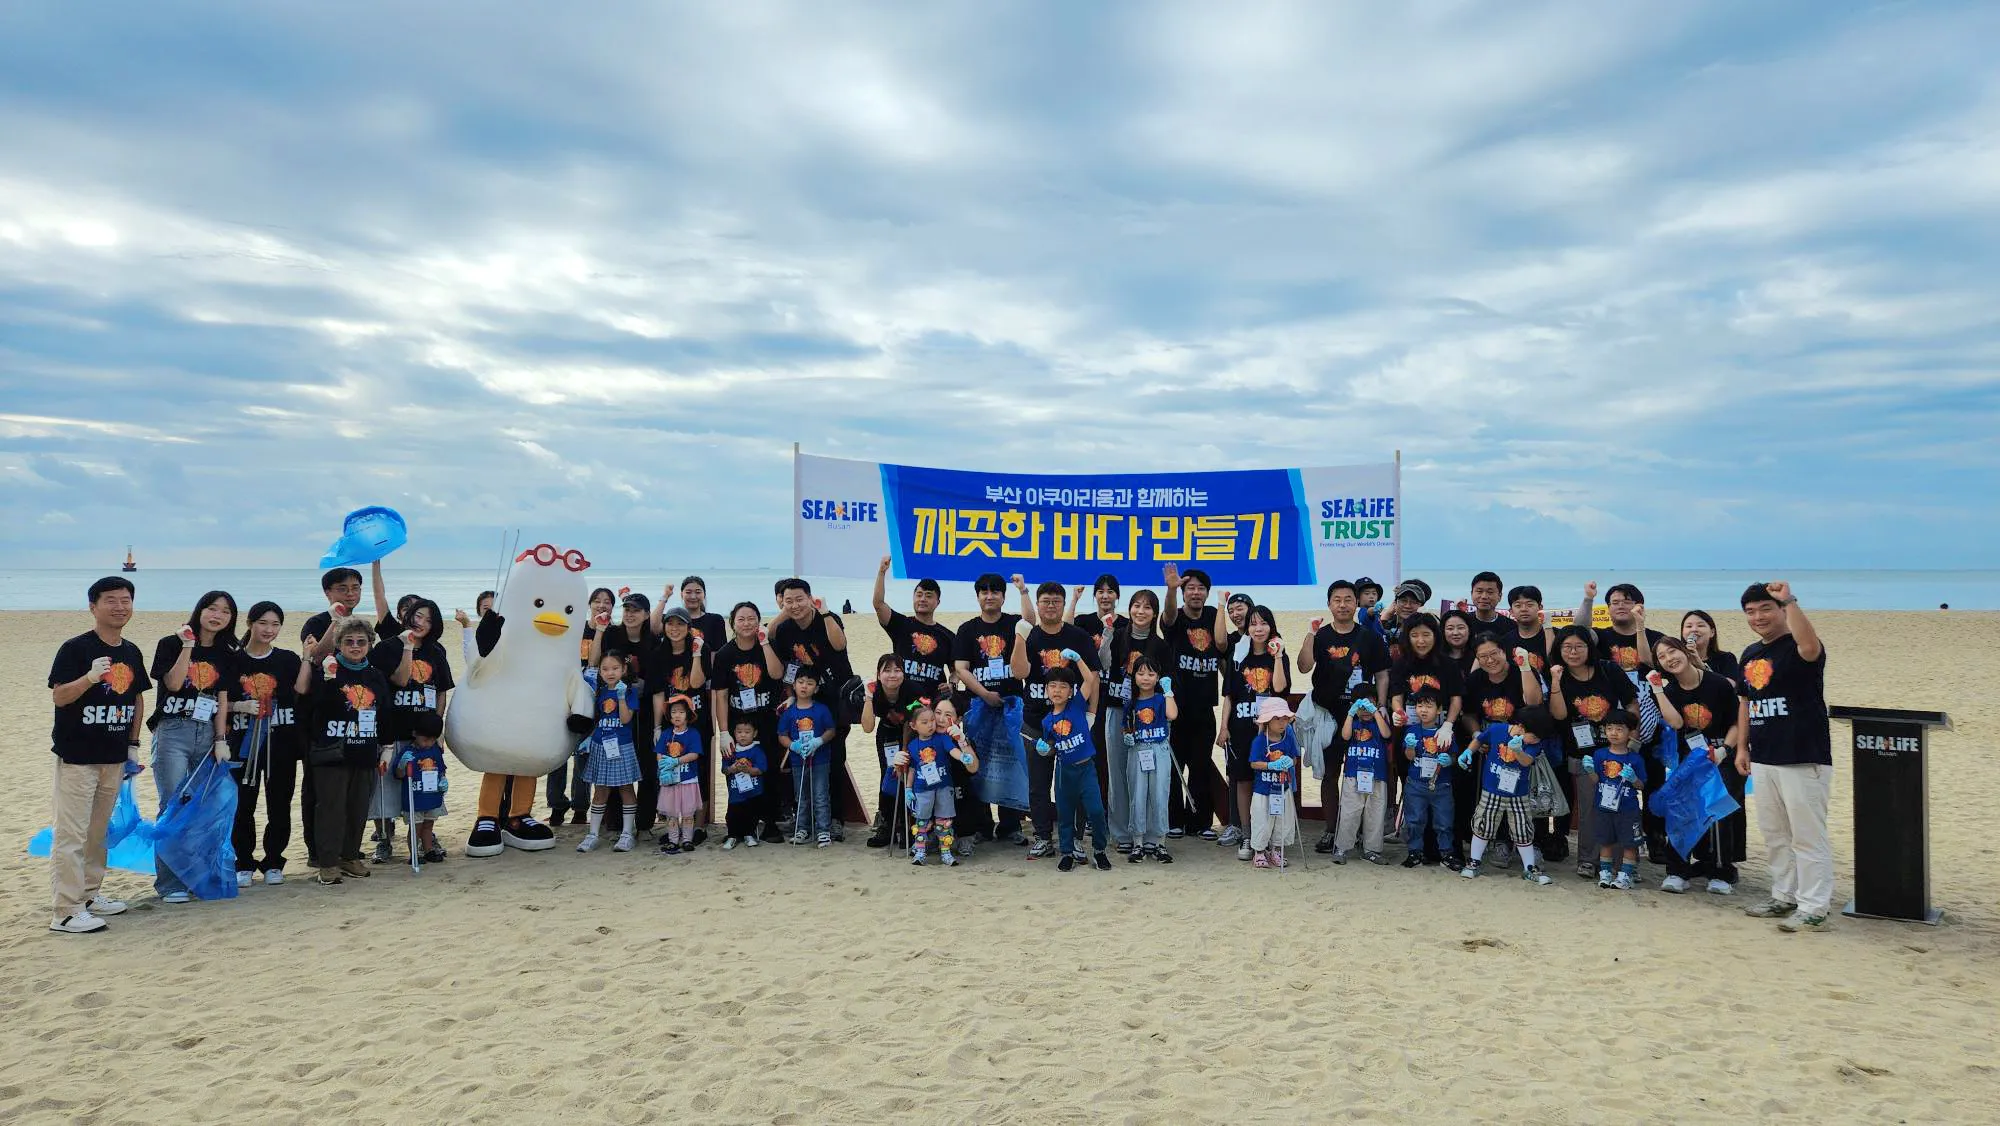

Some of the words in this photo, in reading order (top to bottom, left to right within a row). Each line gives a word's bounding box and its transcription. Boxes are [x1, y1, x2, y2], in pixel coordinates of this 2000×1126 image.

[985, 485, 1022, 505] 부산
[1025, 487, 1133, 508] 아쿠아리움과
[1137, 487, 1209, 508] 함께하는
[801, 499, 837, 520] SEA
[1321, 499, 1356, 519] SEA
[827, 522, 851, 530] Busan
[913, 507, 1045, 559] 깨끗한
[1053, 512, 1143, 561] 바다
[1151, 512, 1280, 561] 만들기
[1321, 520, 1395, 540] TRUST
[903, 659, 918, 675] EA
[394, 690, 421, 706] SEA
[1109, 682, 1122, 697] SE
[82, 705, 118, 725] SEA
[232, 713, 249, 731] SE
[326, 720, 356, 737] SEA
[1856, 735, 1886, 750] SEA
